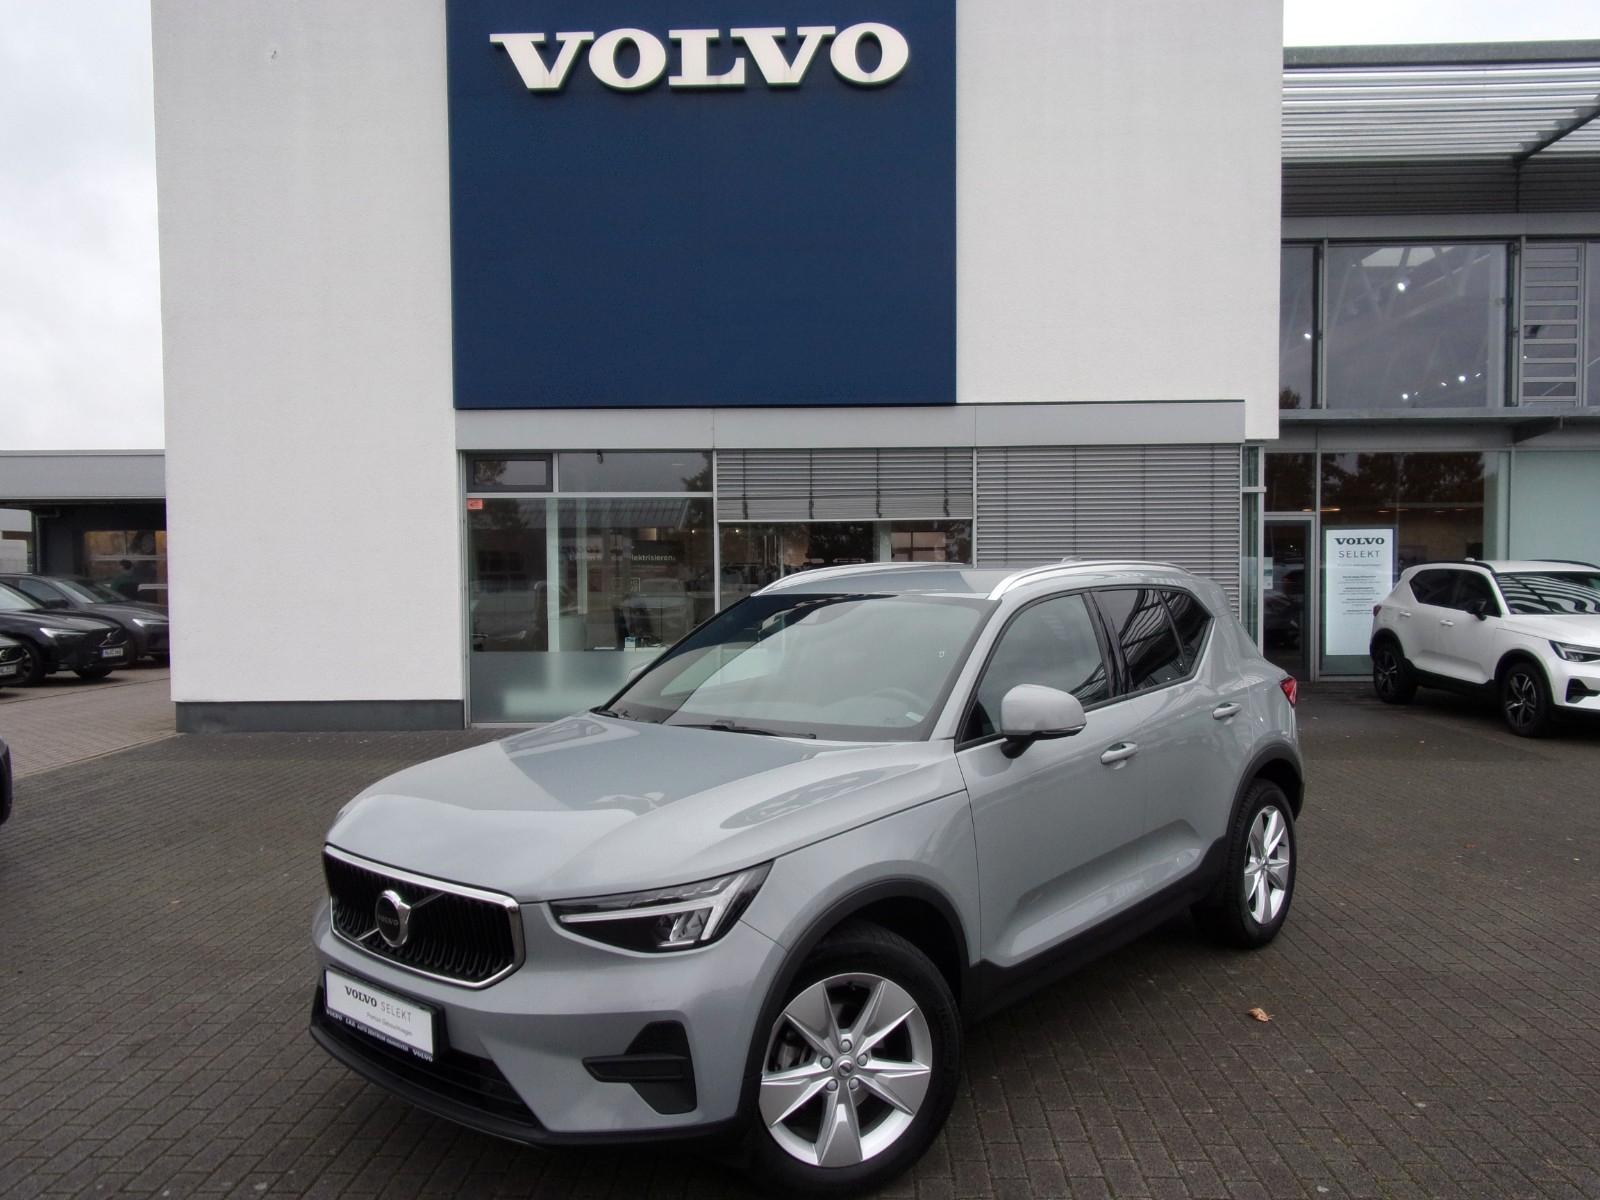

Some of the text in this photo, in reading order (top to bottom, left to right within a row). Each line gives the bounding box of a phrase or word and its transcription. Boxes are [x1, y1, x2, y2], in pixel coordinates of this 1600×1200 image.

[489, 22, 910, 90] VOLVO
[1335, 537, 1385, 545] VOLVO
[1338, 550, 1380, 558] SELEKT
[344, 985, 411, 1023] VOLVO SELEKT
